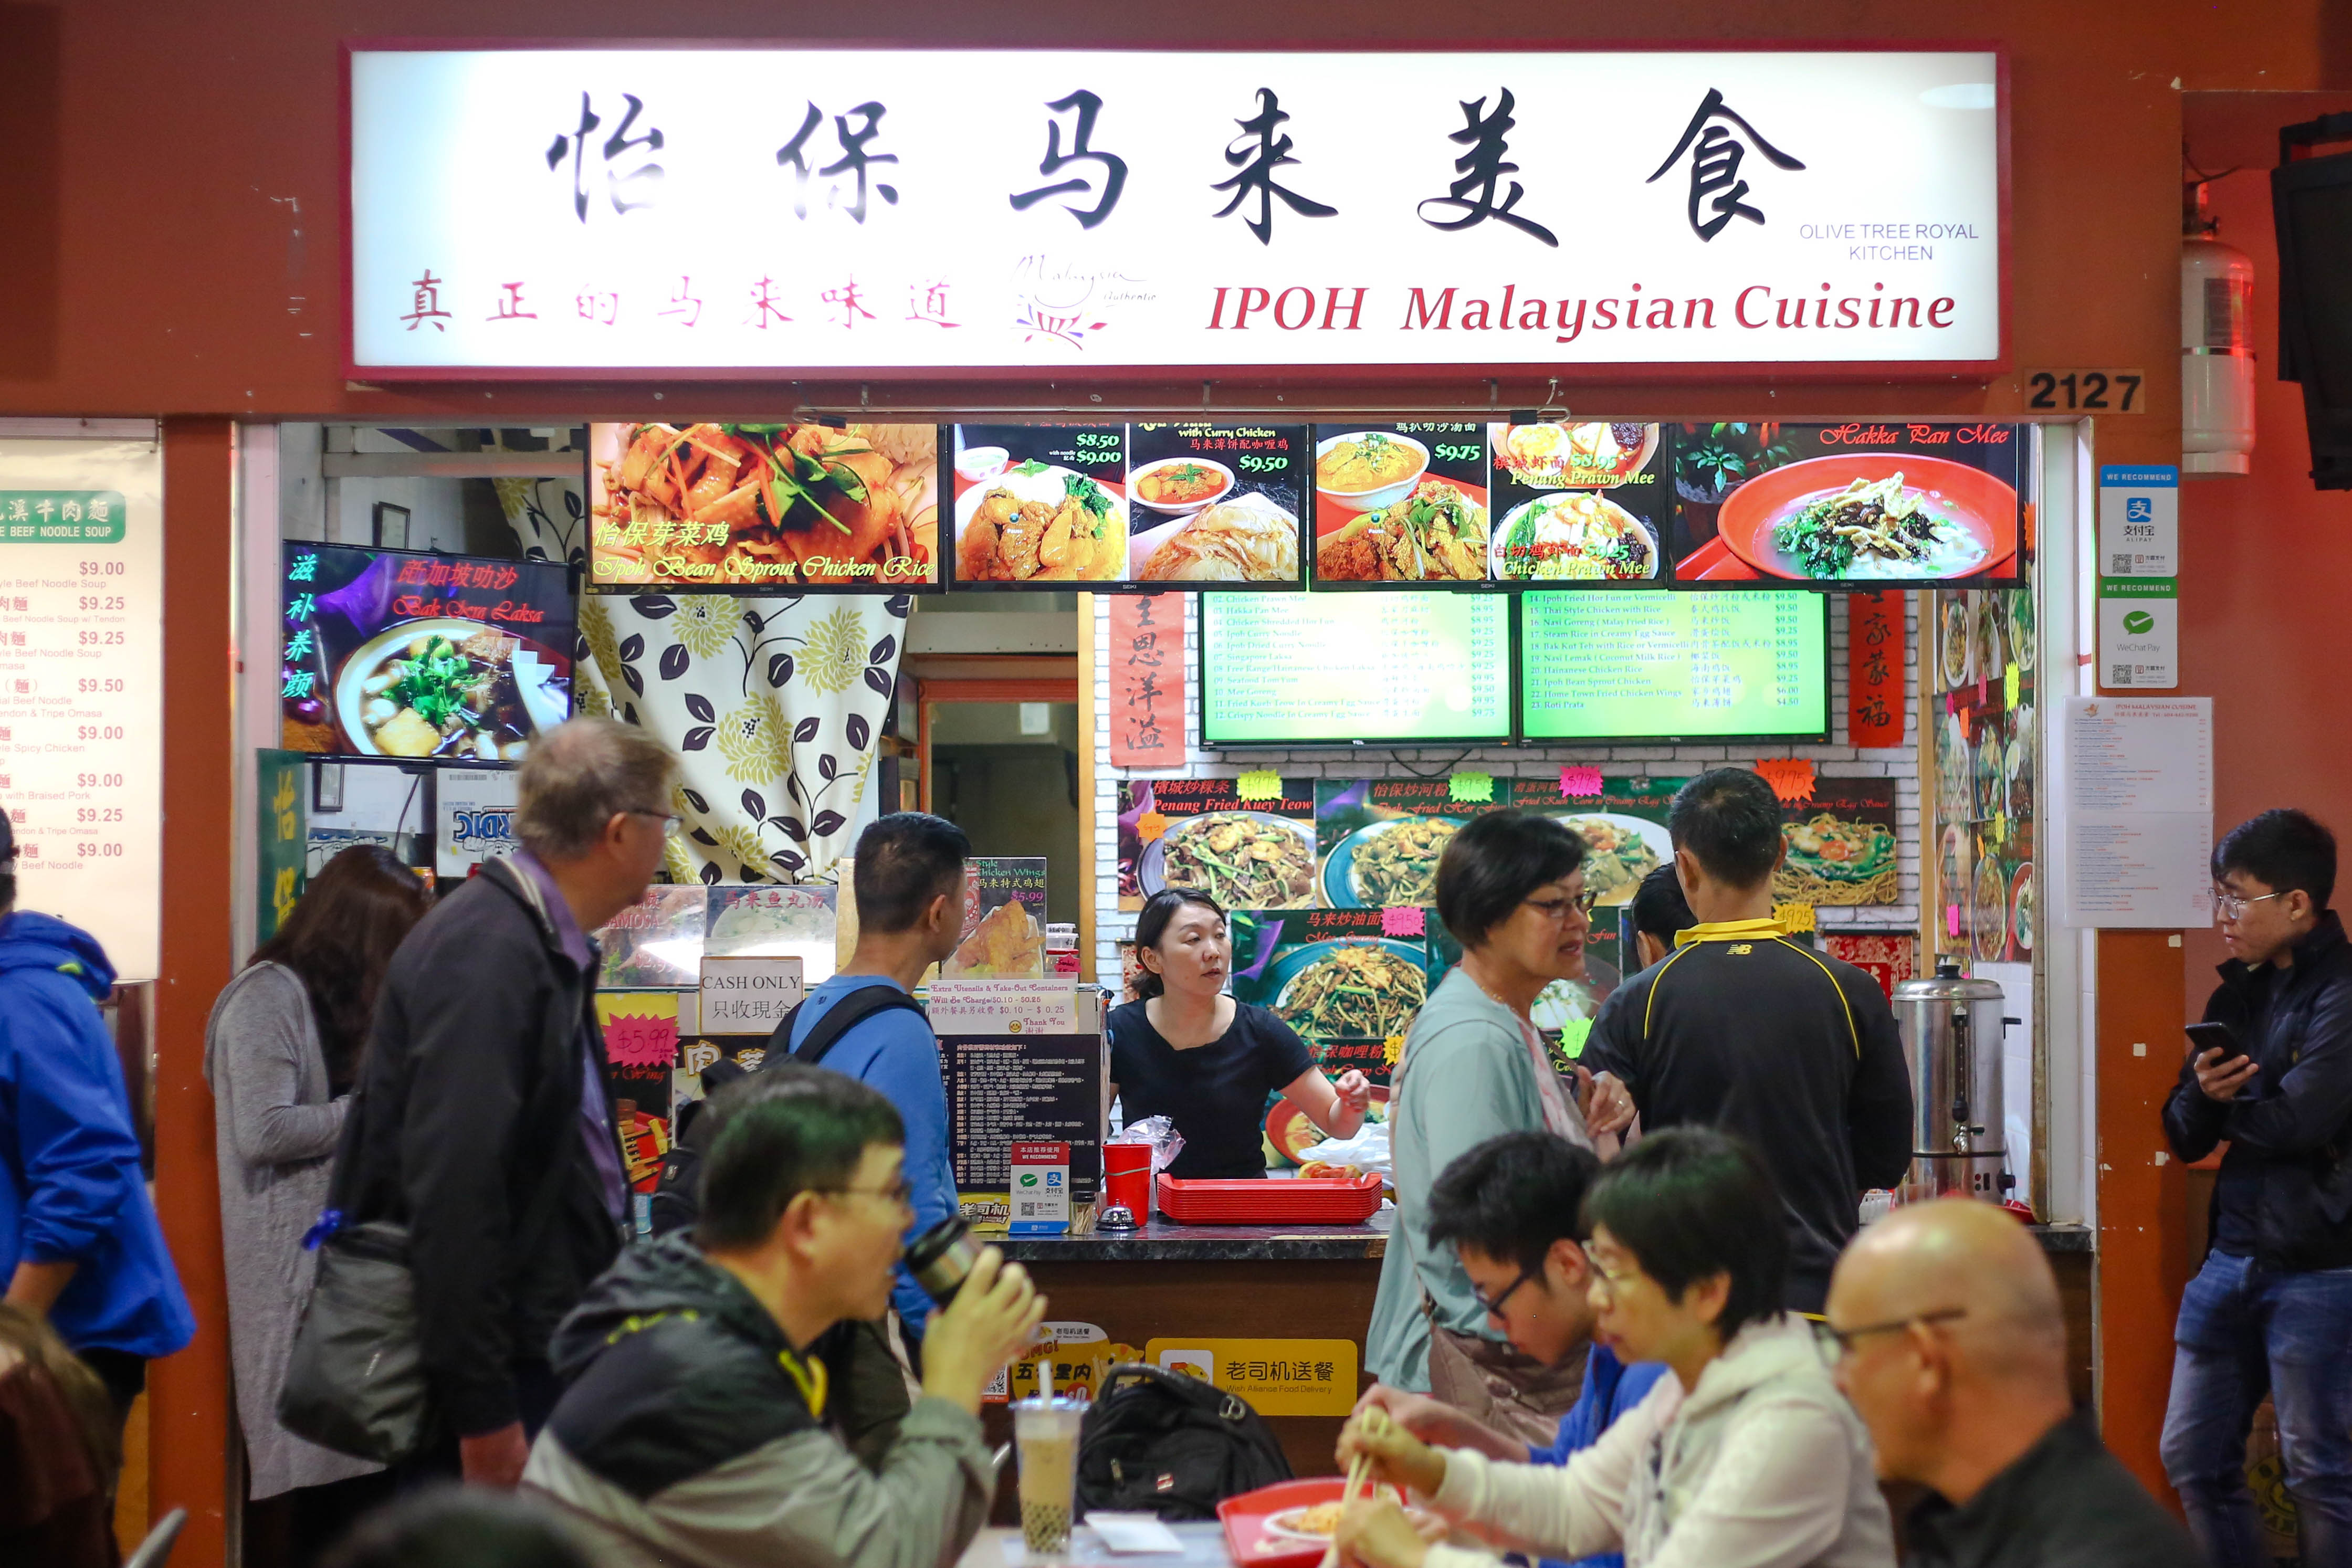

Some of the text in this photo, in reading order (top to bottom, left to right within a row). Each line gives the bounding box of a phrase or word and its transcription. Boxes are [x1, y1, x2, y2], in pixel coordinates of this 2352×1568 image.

[545, 87, 1807, 247] 怡保马来美食
[1799, 223, 1980, 240] OLIVE TREE ROYAL
[1849, 245, 1934, 261] KITCHEN
[399, 268, 962, 332] 真正的马来味道
[1205, 282, 1956, 344] IPOH Malaysian Cuisine
[2030, 372, 2141, 411] 2127
[1178, 427, 1276, 439] with Curry Chicken
[1820, 423, 2010, 445] Hakka Pan Mee
[1076, 433, 1120, 449] $8.50
[1076, 449, 1121, 466] $9.00
[1434, 443, 1481, 461] $9.75
[1239, 454, 1288, 472] $9.50
[1570, 453, 1618, 470] $8.95
[1510, 471, 1655, 489] Penang Prawn Mee
[10, 527, 35, 536] BEEF
[40, 527, 80, 536] NOODLE
[85, 527, 111, 537] SOUP
[594, 520, 731, 547] 怡保芽菜鸡
[2123, 525, 2155, 535] 支付宝
[1584, 543, 1630, 560] $9.25
[79, 561, 124, 576] $9.00
[592, 555, 936, 583] Ipoh Bean Sprout Chicken Rice
[1502, 561, 1651, 575] Chicken Prawn Mee
[16, 580, 106, 590] Beef Noodle Soup
[79, 596, 124, 611] $9.25
[1544, 595, 1562, 603] Ipoh
[58, 615, 79, 624] Soup
[281, 553, 318, 699] 滋补养颜
[1564, 619, 1595, 628] Goreng
[79, 630, 124, 646] $9.25
[15, 649, 101, 659] Beef Noodle Soup
[2147, 644, 2160, 653] Pay
[78, 678, 123, 693] $9.50
[1544, 679, 1562, 688] Ipoh
[13, 696, 72, 704] Beef Noodle
[41, 709, 102, 719] Tripe Omasa
[78, 725, 123, 740] $9.00
[15, 743, 85, 754] Spicy Chicken
[77, 773, 122, 788] $9.00
[1373, 783, 1449, 797] 怡保炒河粉
[1154, 798, 1312, 813] Penang Fried Kuey Teow
[77, 808, 122, 823] $9.25
[47, 827, 67, 836] Tripe
[77, 843, 122, 858] $9.00
[976, 859, 998, 869] Style
[1013, 868, 1046, 878] Wings
[979, 878, 1045, 889] 马来特式鸡翅
[723, 890, 826, 909] 马来鱼丸汤
[1011, 890, 1044, 902] $5.99
[1307, 912, 1383, 926] 马来炒油面
[702, 976, 801, 989] CASH ONLY
[954, 984, 983, 992] Utensils
[993, 984, 1026, 992] Take-Out
[713, 1000, 792, 1019] 只收現金
[1049, 1017, 1065, 1026] You
[616, 1029, 669, 1053] $5.99
[959, 1203, 1011, 1216] 老司机
[1226, 1361, 1334, 1381] 老司机送餐
[1300, 1385, 1332, 1394] Delivery
